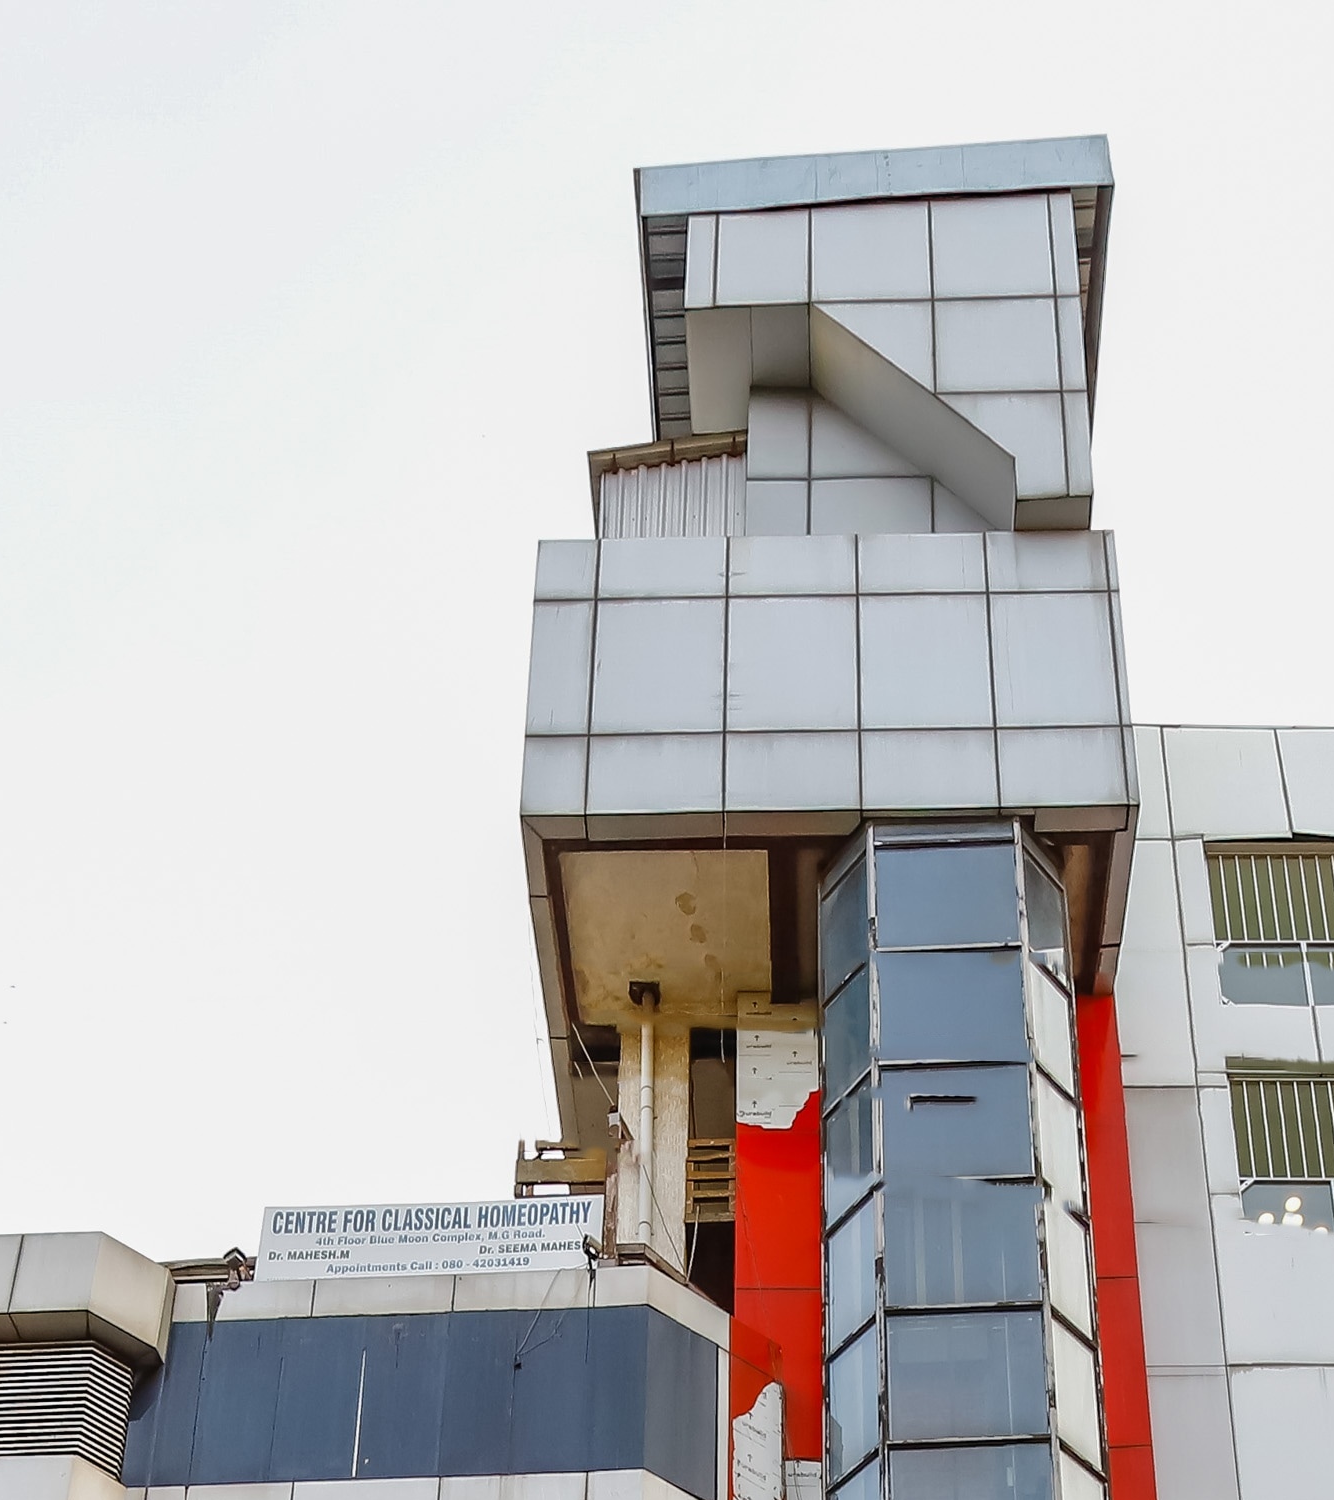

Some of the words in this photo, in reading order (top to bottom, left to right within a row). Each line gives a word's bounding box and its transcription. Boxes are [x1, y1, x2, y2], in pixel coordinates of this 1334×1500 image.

[272, 1210, 338, 1234] CENTRE
[342, 1209, 376, 1233] FOR
[381, 1206, 471, 1232] CLASSICAL
[477, 1201, 592, 1229] HOMEOPATHY
[316, 1236, 334, 1246] 4th
[338, 1235, 366, 1245] Floor
[369, 1235, 395, 1244] Blue
[398, 1234, 428, 1243] Moon
[432, 1231, 484, 1244] Complex,
[479, 1245, 494, 1255] Dr.
[498, 1243, 537, 1254] SEEMA
[540, 1240, 582, 1251] MAHES
[268, 1251, 284, 1261] Dr.
[287, 1250, 350, 1260] MAHESH.M
[326, 1262, 407, 1275] Appointments
[410, 1260, 433, 1271] Call
[441, 1259, 464, 1270] 080
[472, 1256, 531, 1269] 42031419
